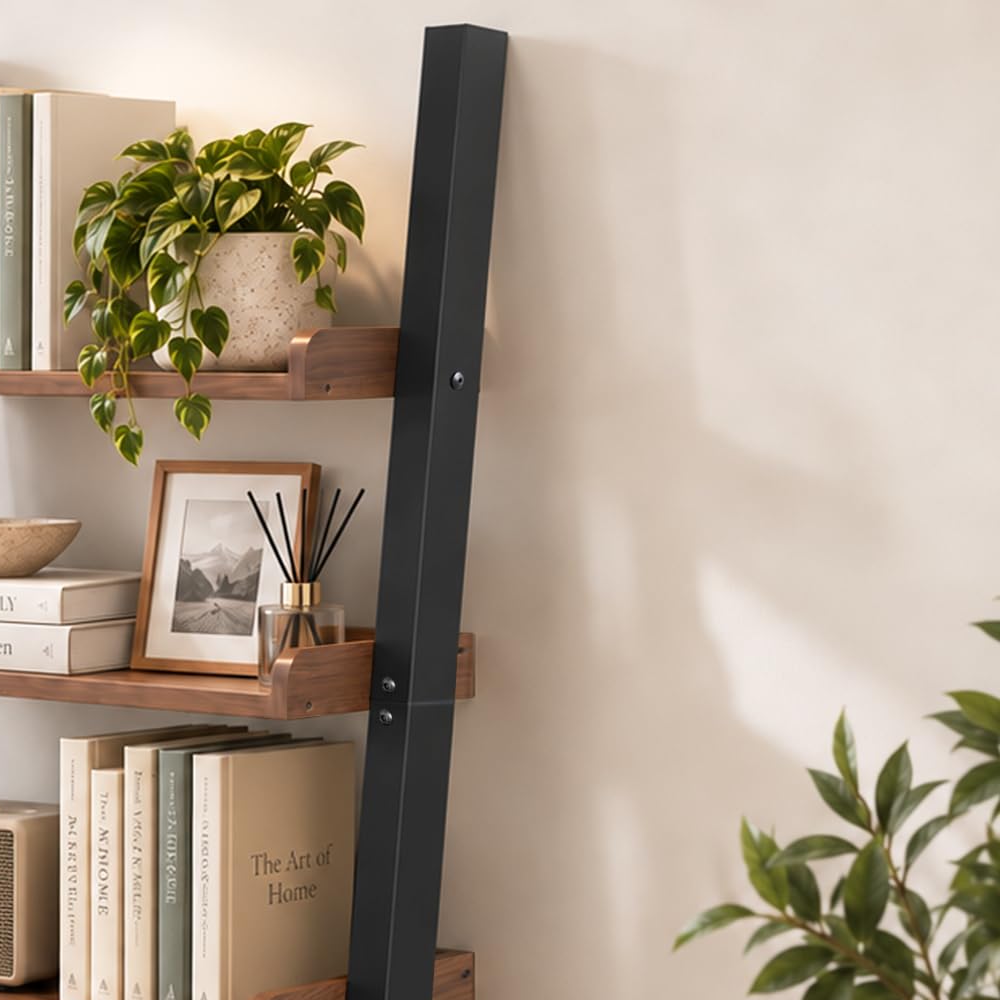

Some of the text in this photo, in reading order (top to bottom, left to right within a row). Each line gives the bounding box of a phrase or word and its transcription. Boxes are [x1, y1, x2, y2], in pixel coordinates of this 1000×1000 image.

[250, 842, 334, 876] The Art of
[267, 881, 318, 905] Home
